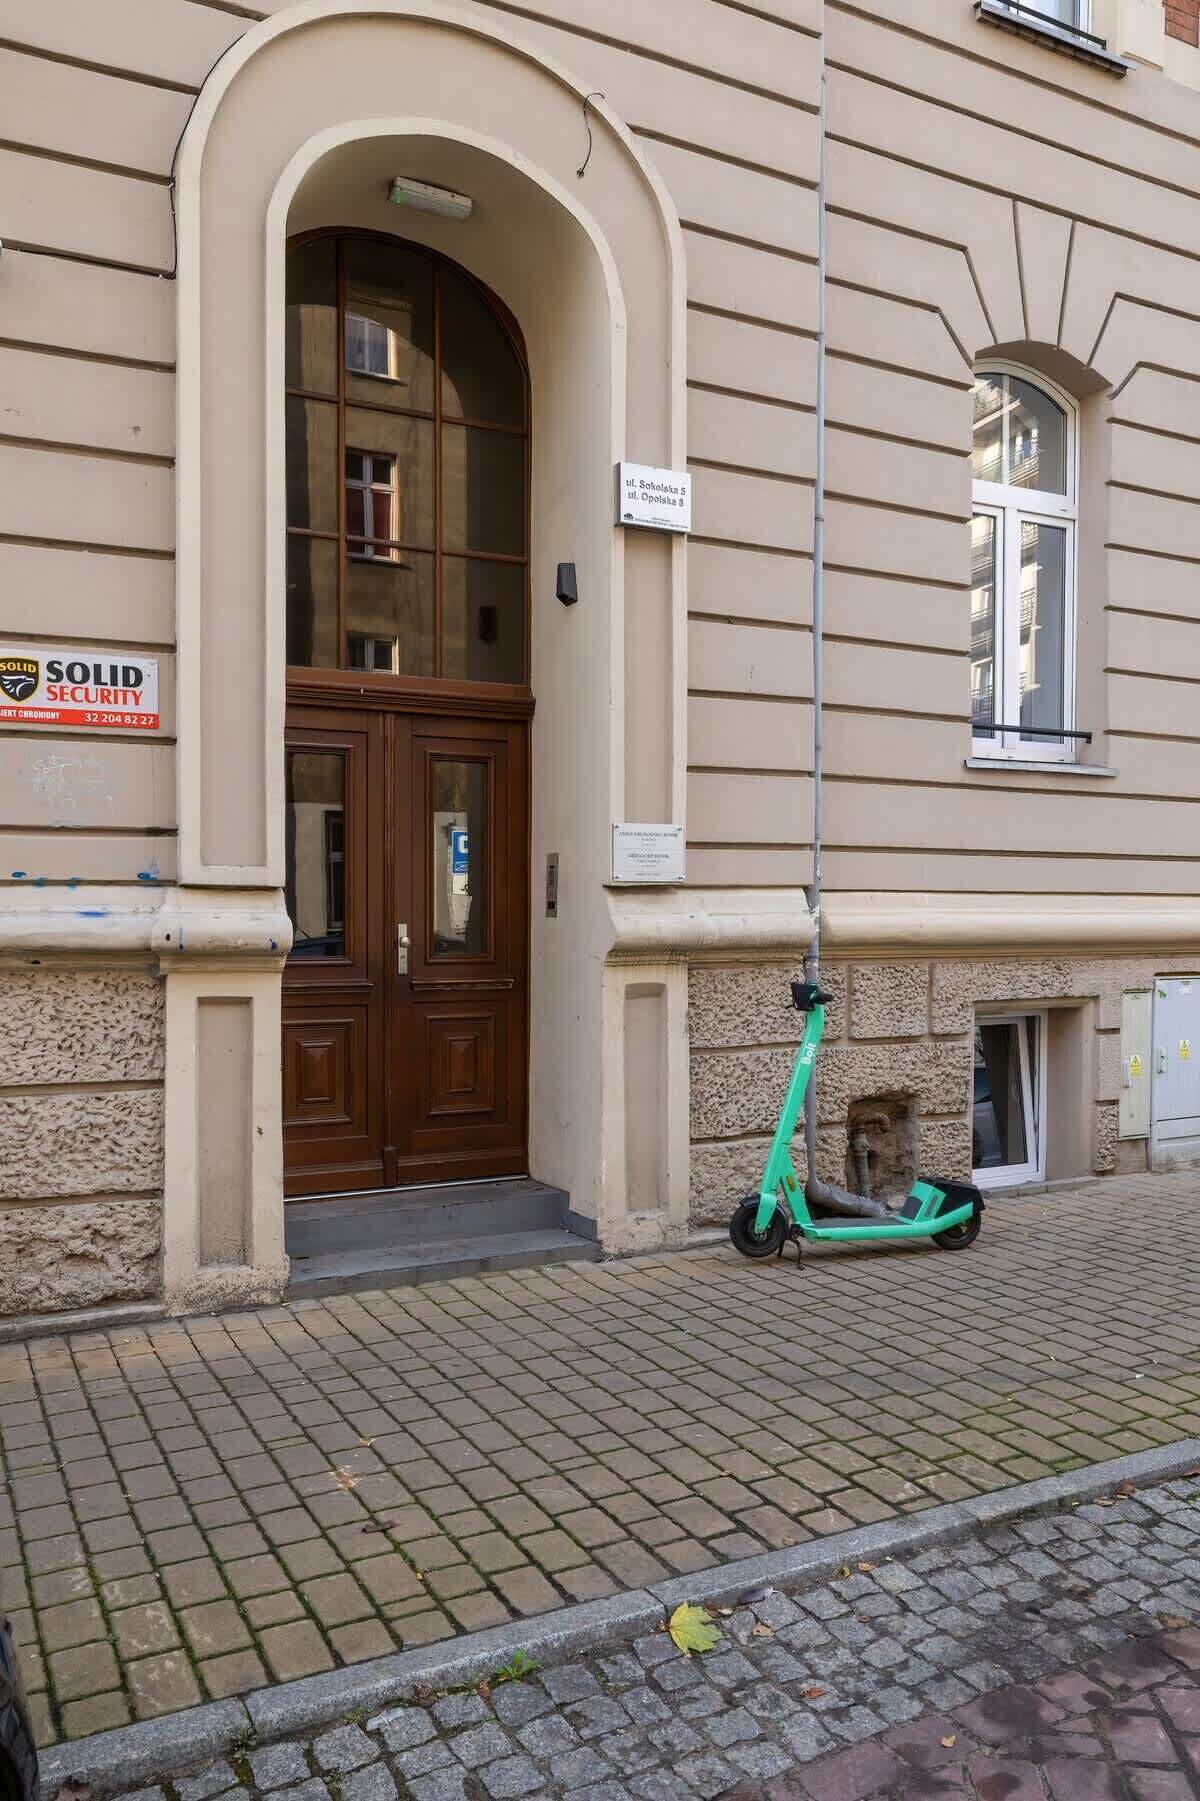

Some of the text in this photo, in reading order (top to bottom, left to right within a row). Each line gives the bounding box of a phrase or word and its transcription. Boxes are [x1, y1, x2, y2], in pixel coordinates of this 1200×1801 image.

[626, 479, 686, 496] ul. Sokolska 5
[628, 491, 684, 507] ul. Opolska 8
[0, 662, 37, 673] SOLID
[46, 660, 143, 688] SOLID
[47, 685, 143, 706] SECURITY
[0, 709, 60, 720] IEKT CHRONIONY
[85, 712, 154, 725] 32 204 82 27
[801, 1042, 816, 1065] Bolt
